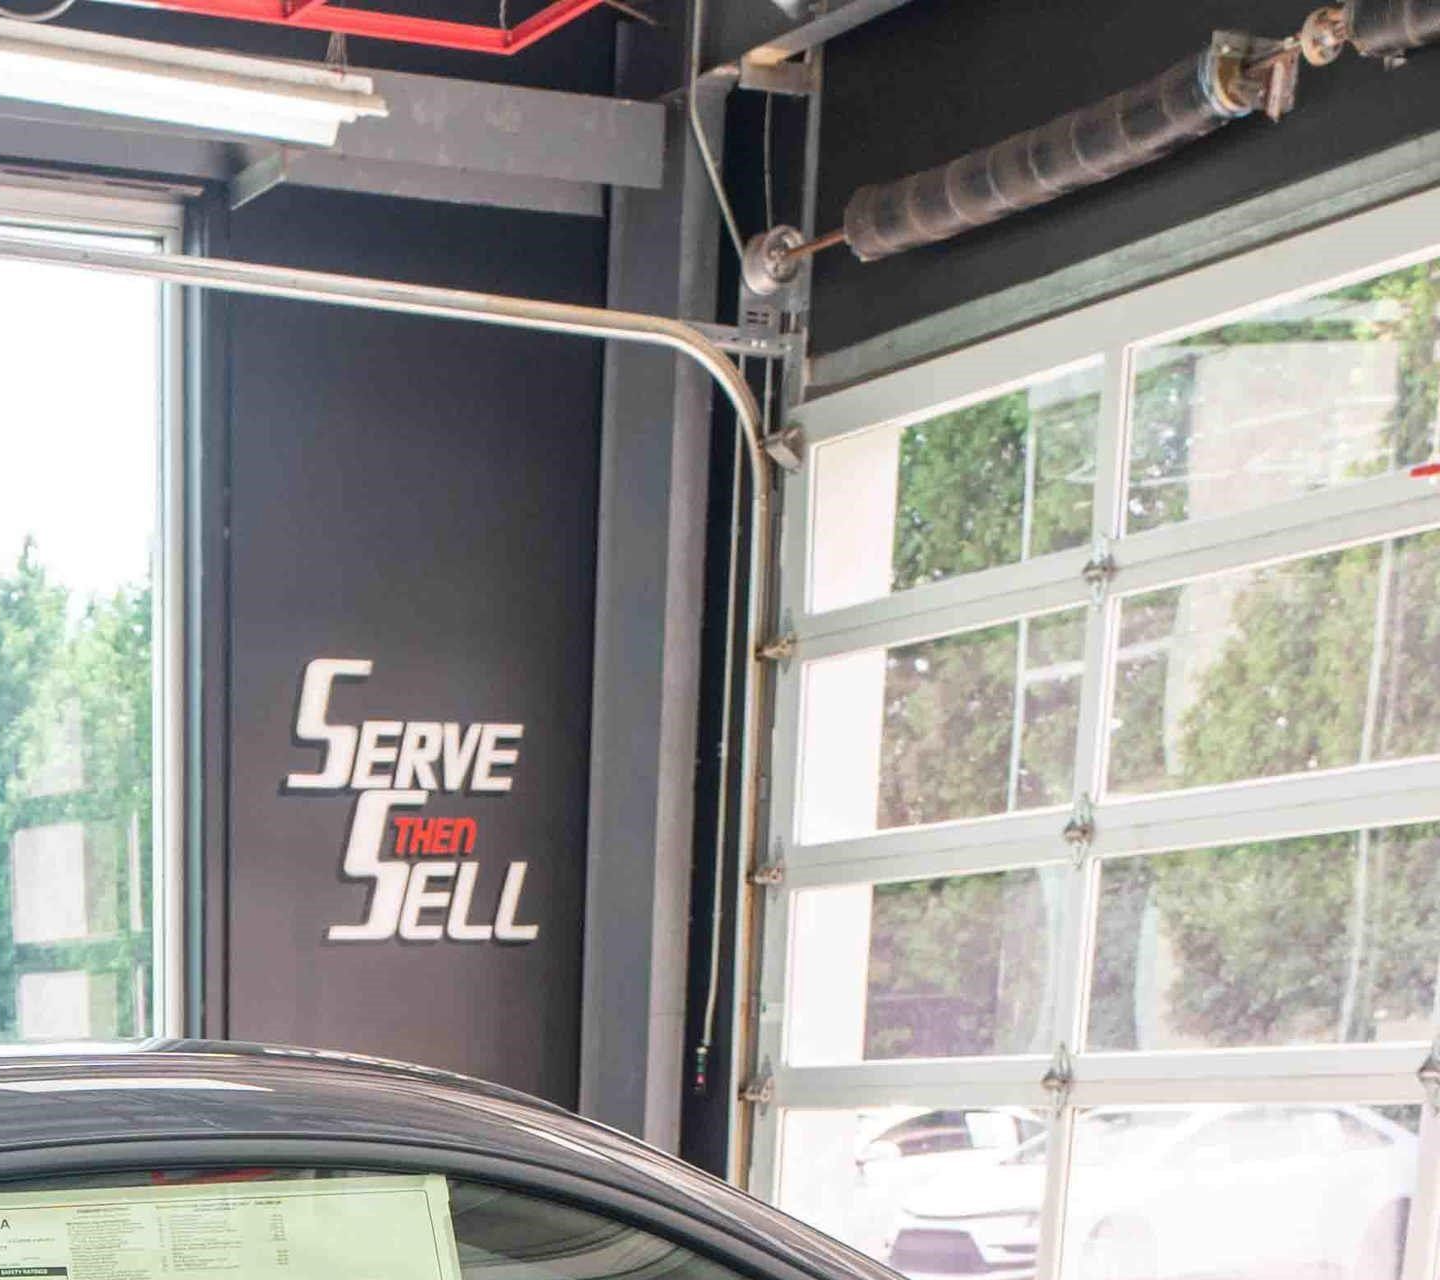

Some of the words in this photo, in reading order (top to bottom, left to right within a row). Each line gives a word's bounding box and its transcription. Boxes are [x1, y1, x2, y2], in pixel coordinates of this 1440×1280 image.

[286, 658, 523, 791] SERVE
[327, 790, 539, 940] SELL
[392, 817, 477, 854] THEN
